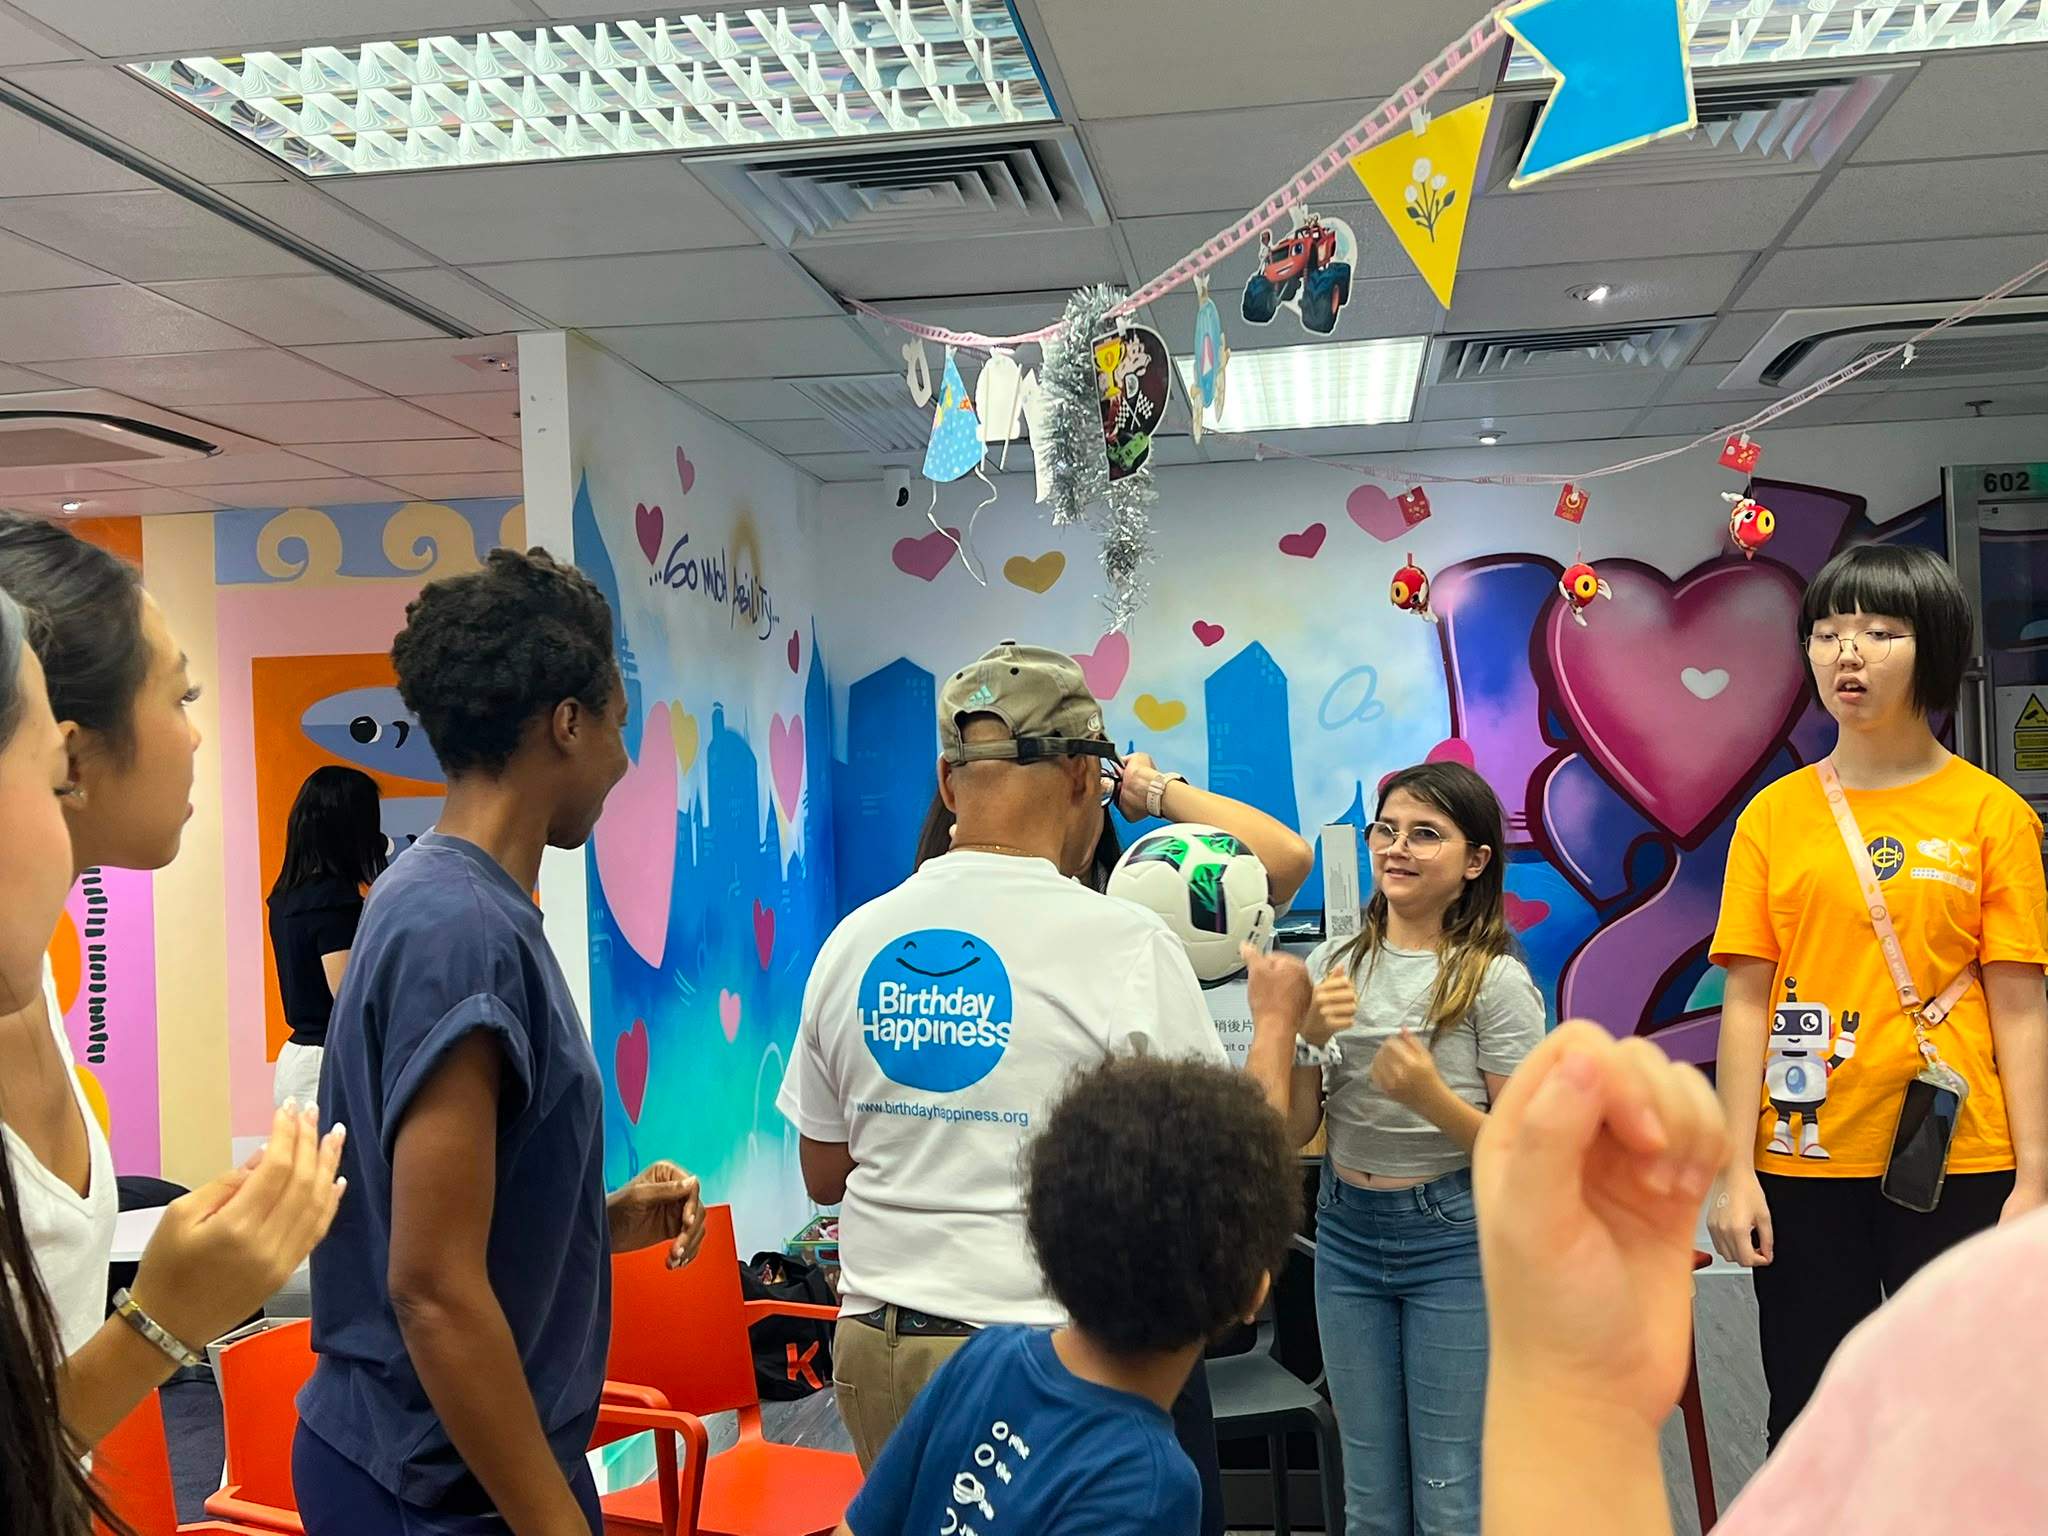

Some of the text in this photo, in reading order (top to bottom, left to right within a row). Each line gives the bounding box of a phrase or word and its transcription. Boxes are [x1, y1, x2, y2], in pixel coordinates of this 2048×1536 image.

[1983, 471, 2031, 493] 602
[878, 981, 996, 1025] Birthday
[858, 1007, 1012, 1051] Happiness
[857, 1101, 1029, 1126] www.birthdayhappiness.org
[786, 1340, 824, 1389] K
